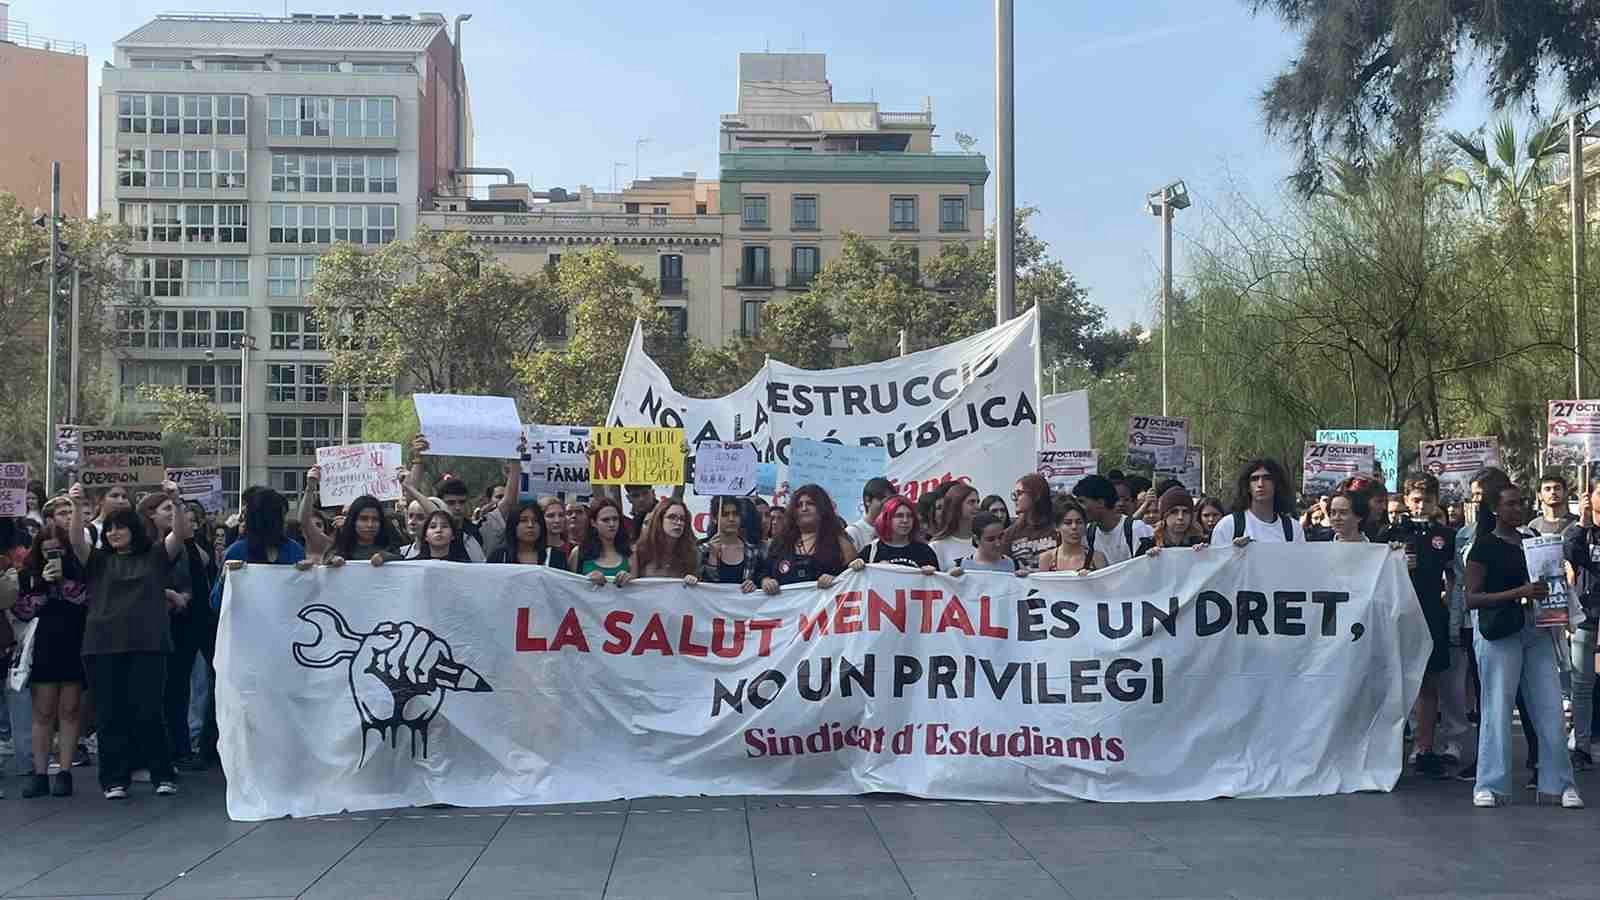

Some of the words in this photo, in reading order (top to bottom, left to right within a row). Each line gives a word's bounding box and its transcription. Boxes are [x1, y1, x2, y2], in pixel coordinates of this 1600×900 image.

[640, 386, 684, 428] NO
[1554, 403, 1576, 417] 27
[1133, 417, 1149, 429] 27
[1041, 451, 1057, 463] 27
[1310, 445, 1328, 457] 27
[1328, 446, 1369, 455] OCTUBRE
[1425, 443, 1445, 457] 27
[1446, 440, 1489, 451] OCTUBRE
[594, 447, 626, 480] NO
[167, 471, 183, 483] 27
[515, 606, 590, 653] LA
[602, 610, 782, 658] SALUT
[800, 589, 1008, 642] MENTAL
[1017, 589, 1081, 641] ÉS
[1097, 596, 1179, 639] UN
[1195, 590, 1366, 643] DRET,
[711, 668, 788, 717] NO
[796, 656, 876, 701] UN
[893, 653, 1165, 705] PRIVILEGI
[744, 721, 886, 759] Sindicat
